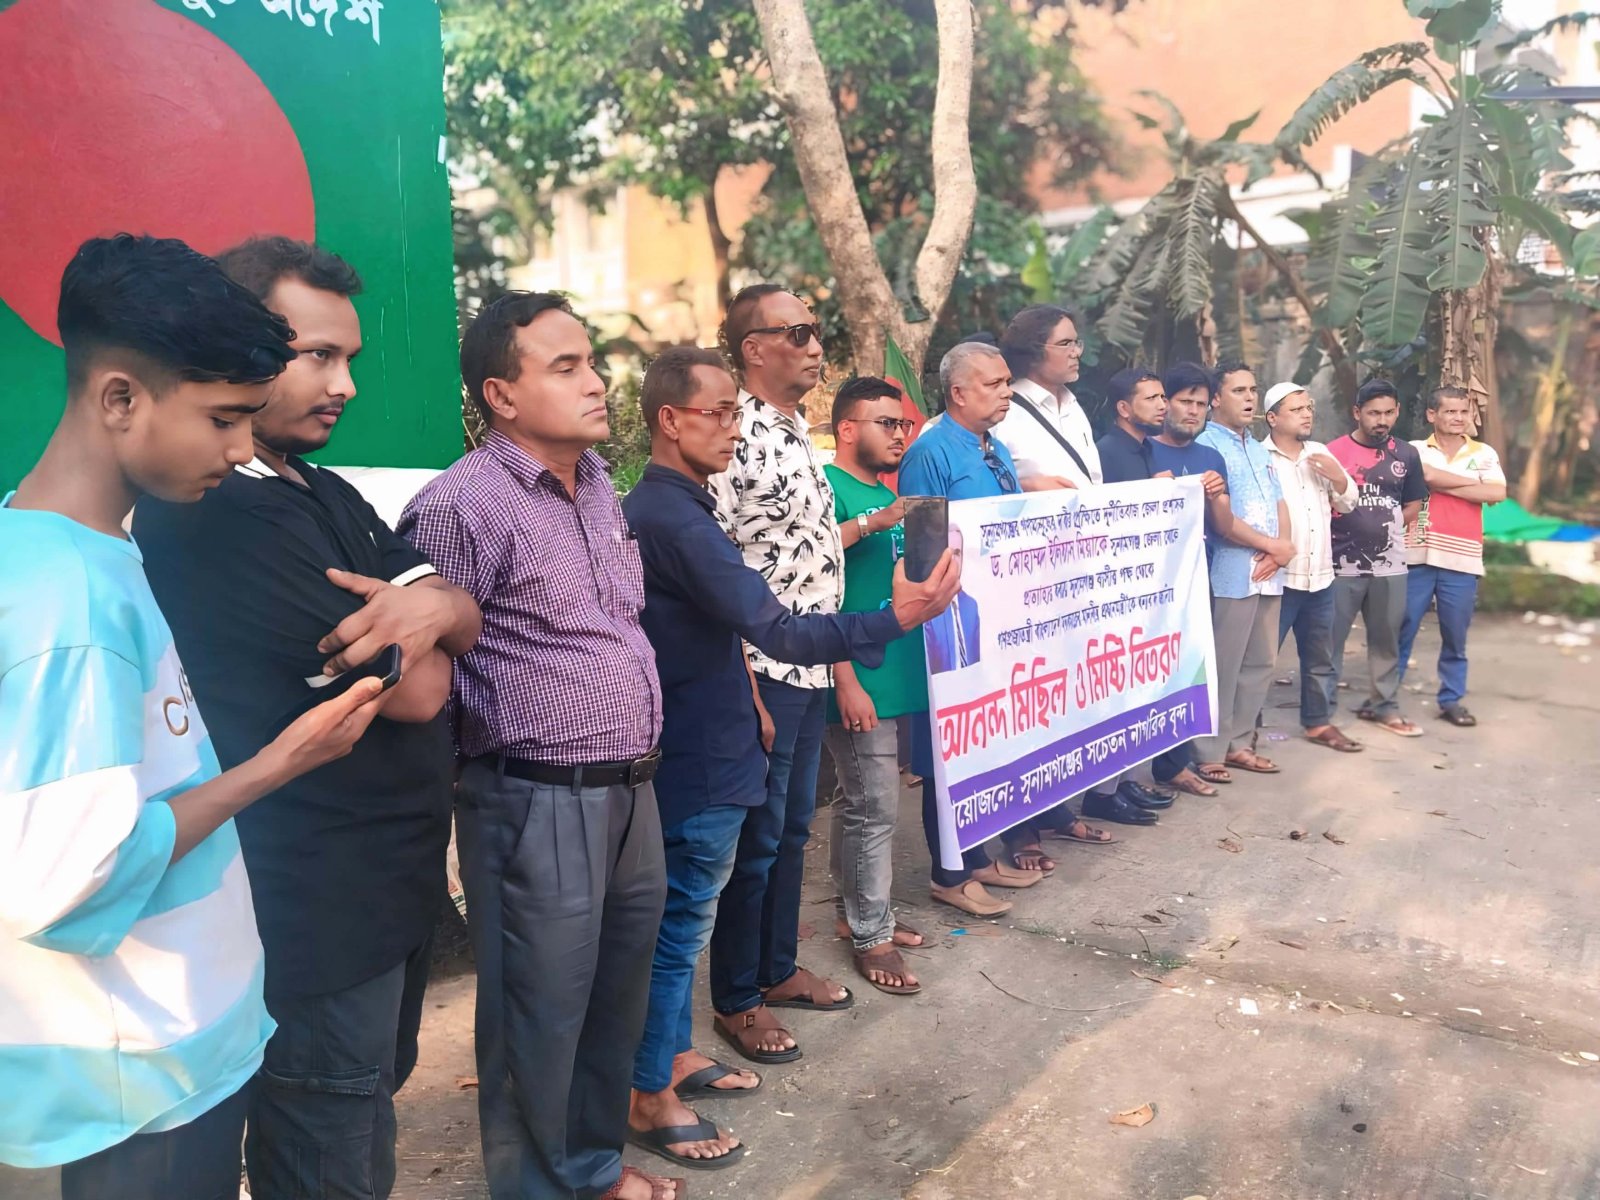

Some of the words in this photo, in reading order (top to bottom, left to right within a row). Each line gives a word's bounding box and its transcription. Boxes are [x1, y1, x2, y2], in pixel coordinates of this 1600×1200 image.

[1142, 501, 1160, 518] জেলা
[1076, 531, 1108, 560] মিয়াকে
[1143, 531, 1162, 549] জেলা
[1120, 566, 1133, 583] পক্ষ
[1135, 563, 1155, 580] থেকে
[936, 688, 1008, 762] আনন্দ
[1010, 656, 1068, 736] মিছিল
[1075, 662, 1087, 709] ও
[1086, 633, 1126, 704] মিষ্টি
[1129, 626, 1182, 689] বিতরণ
[1020, 746, 1083, 805] সুনামগঞ্জের
[1085, 728, 1127, 766] সচেতন
[1128, 708, 1168, 747] নাগরিক
